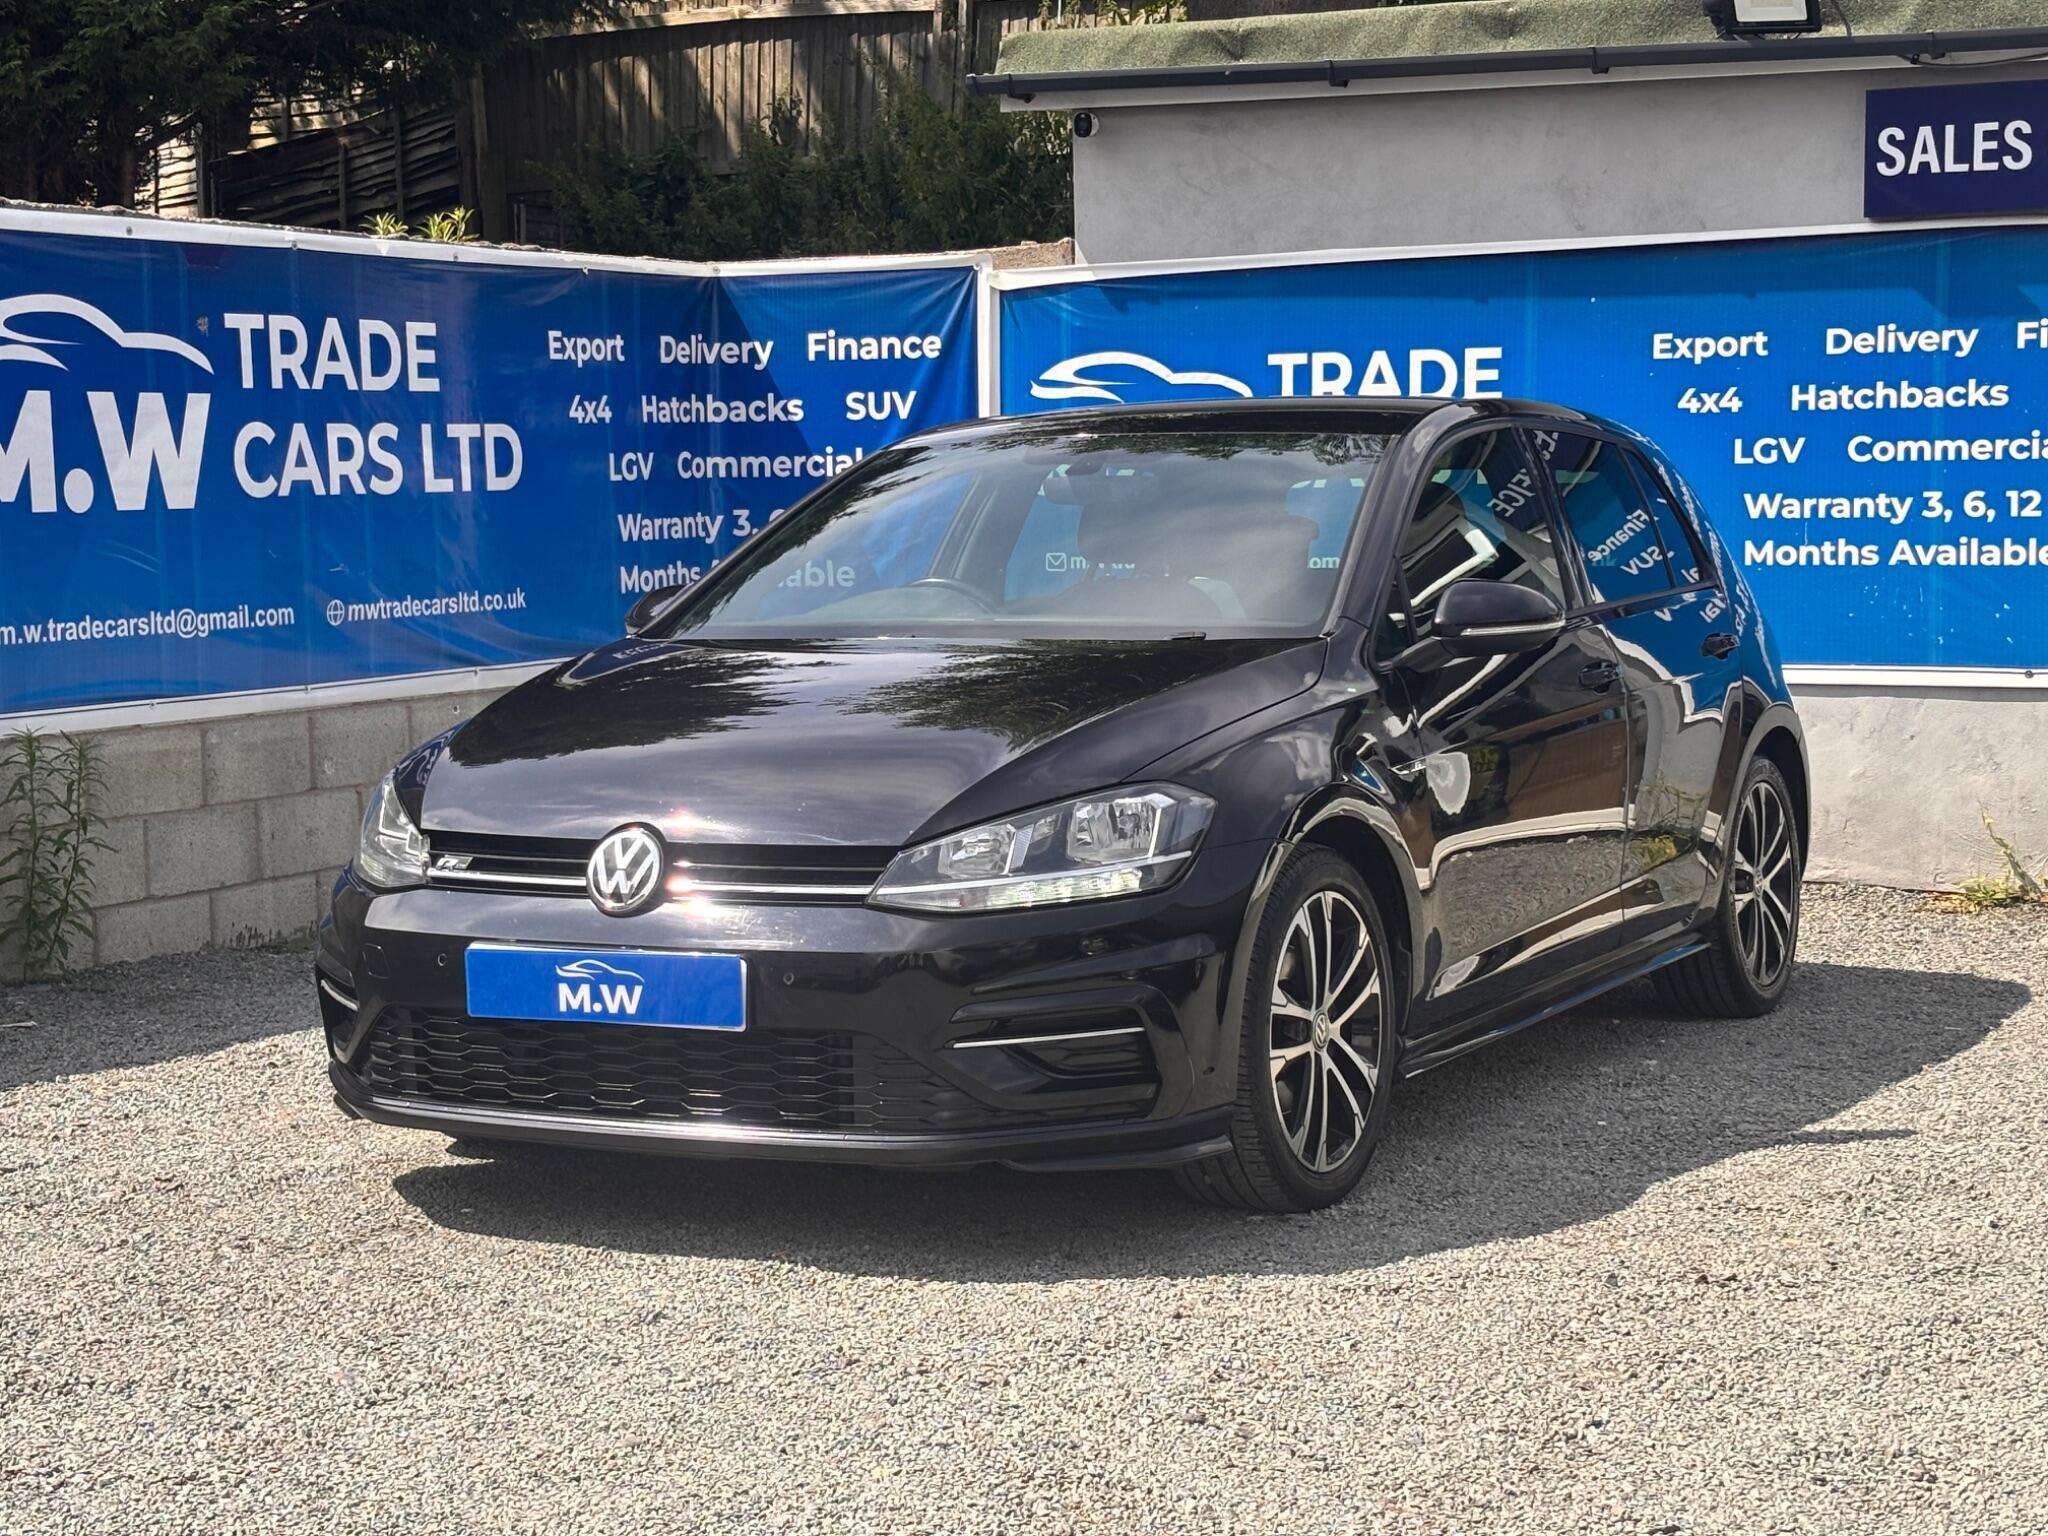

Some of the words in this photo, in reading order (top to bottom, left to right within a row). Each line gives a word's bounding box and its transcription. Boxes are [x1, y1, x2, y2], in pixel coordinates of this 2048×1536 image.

[1876, 119, 2033, 176] SALES
[224, 313, 441, 392] TRADE
[547, 330, 625, 368] Export
[659, 334, 774, 371] Delivery
[807, 329, 942, 362] Finance
[1652, 331, 1769, 365] Export
[1825, 324, 1979, 358] Delivery
[1267, 346, 1503, 399] TRADE
[568, 394, 613, 424] 4x4
[641, 393, 804, 424] Hatchbacks
[846, 390, 917, 421] SUV
[1677, 386, 1743, 414] 4x4
[1791, 379, 2010, 411] Hatchbacks
[233, 421, 404, 498] CARS
[421, 423, 523, 493] LTD
[609, 452, 654, 482] LGV
[1734, 437, 1806, 465] LGV
[1744, 491, 1914, 525] Warranty
[1921, 490, 1953, 523] 3,
[1963, 490, 1996, 523] 6,
[2005, 489, 2042, 517] 12
[618, 511, 725, 545] Warranty
[1744, 538, 1880, 566] Months
[620, 560, 701, 594] Months
[348, 588, 526, 621] mwtradecarsltd.co.uk
[558, 982, 643, 1015] M.W
